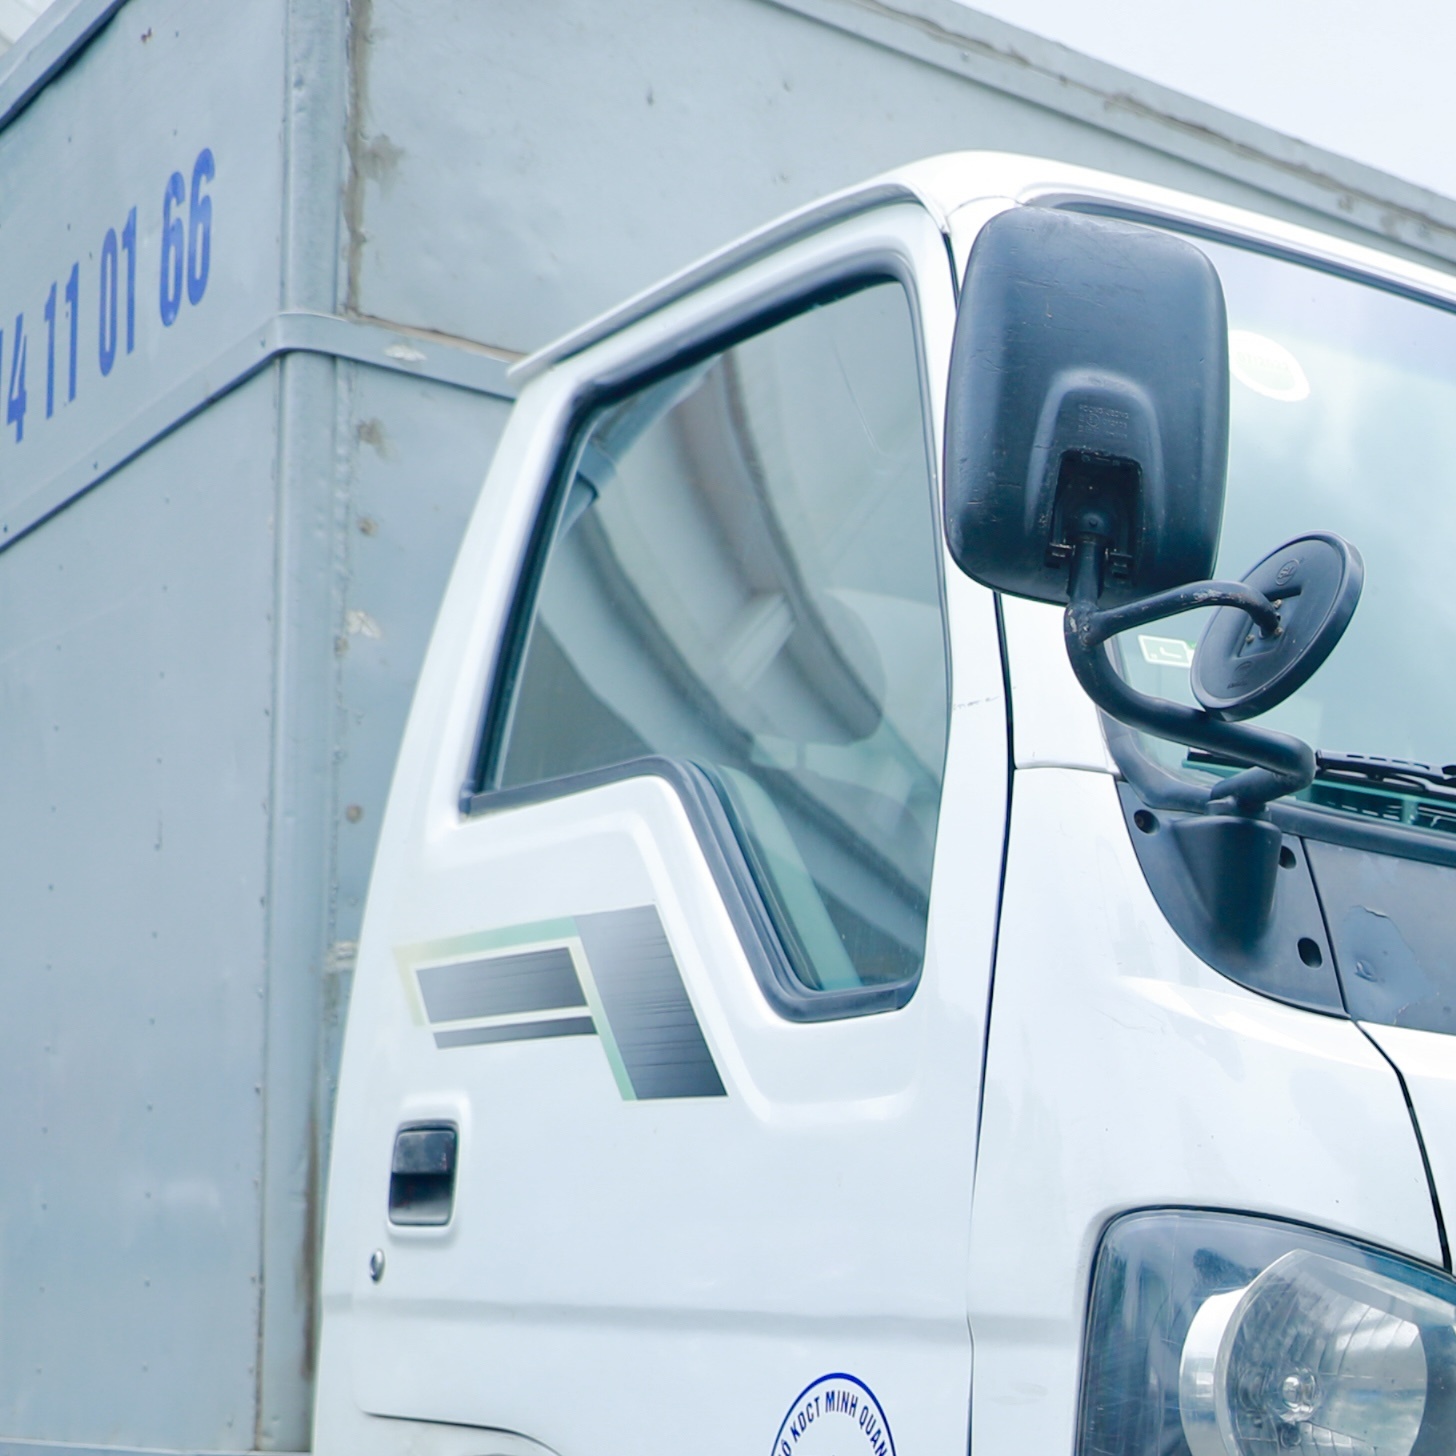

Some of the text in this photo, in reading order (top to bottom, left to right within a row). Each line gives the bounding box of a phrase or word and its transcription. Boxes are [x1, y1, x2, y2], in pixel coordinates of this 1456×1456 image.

[0, 147, 216, 444] 4 11 01 66
[790, 1396, 820, 1443] KDCT
[825, 1389, 858, 1418] MINH
